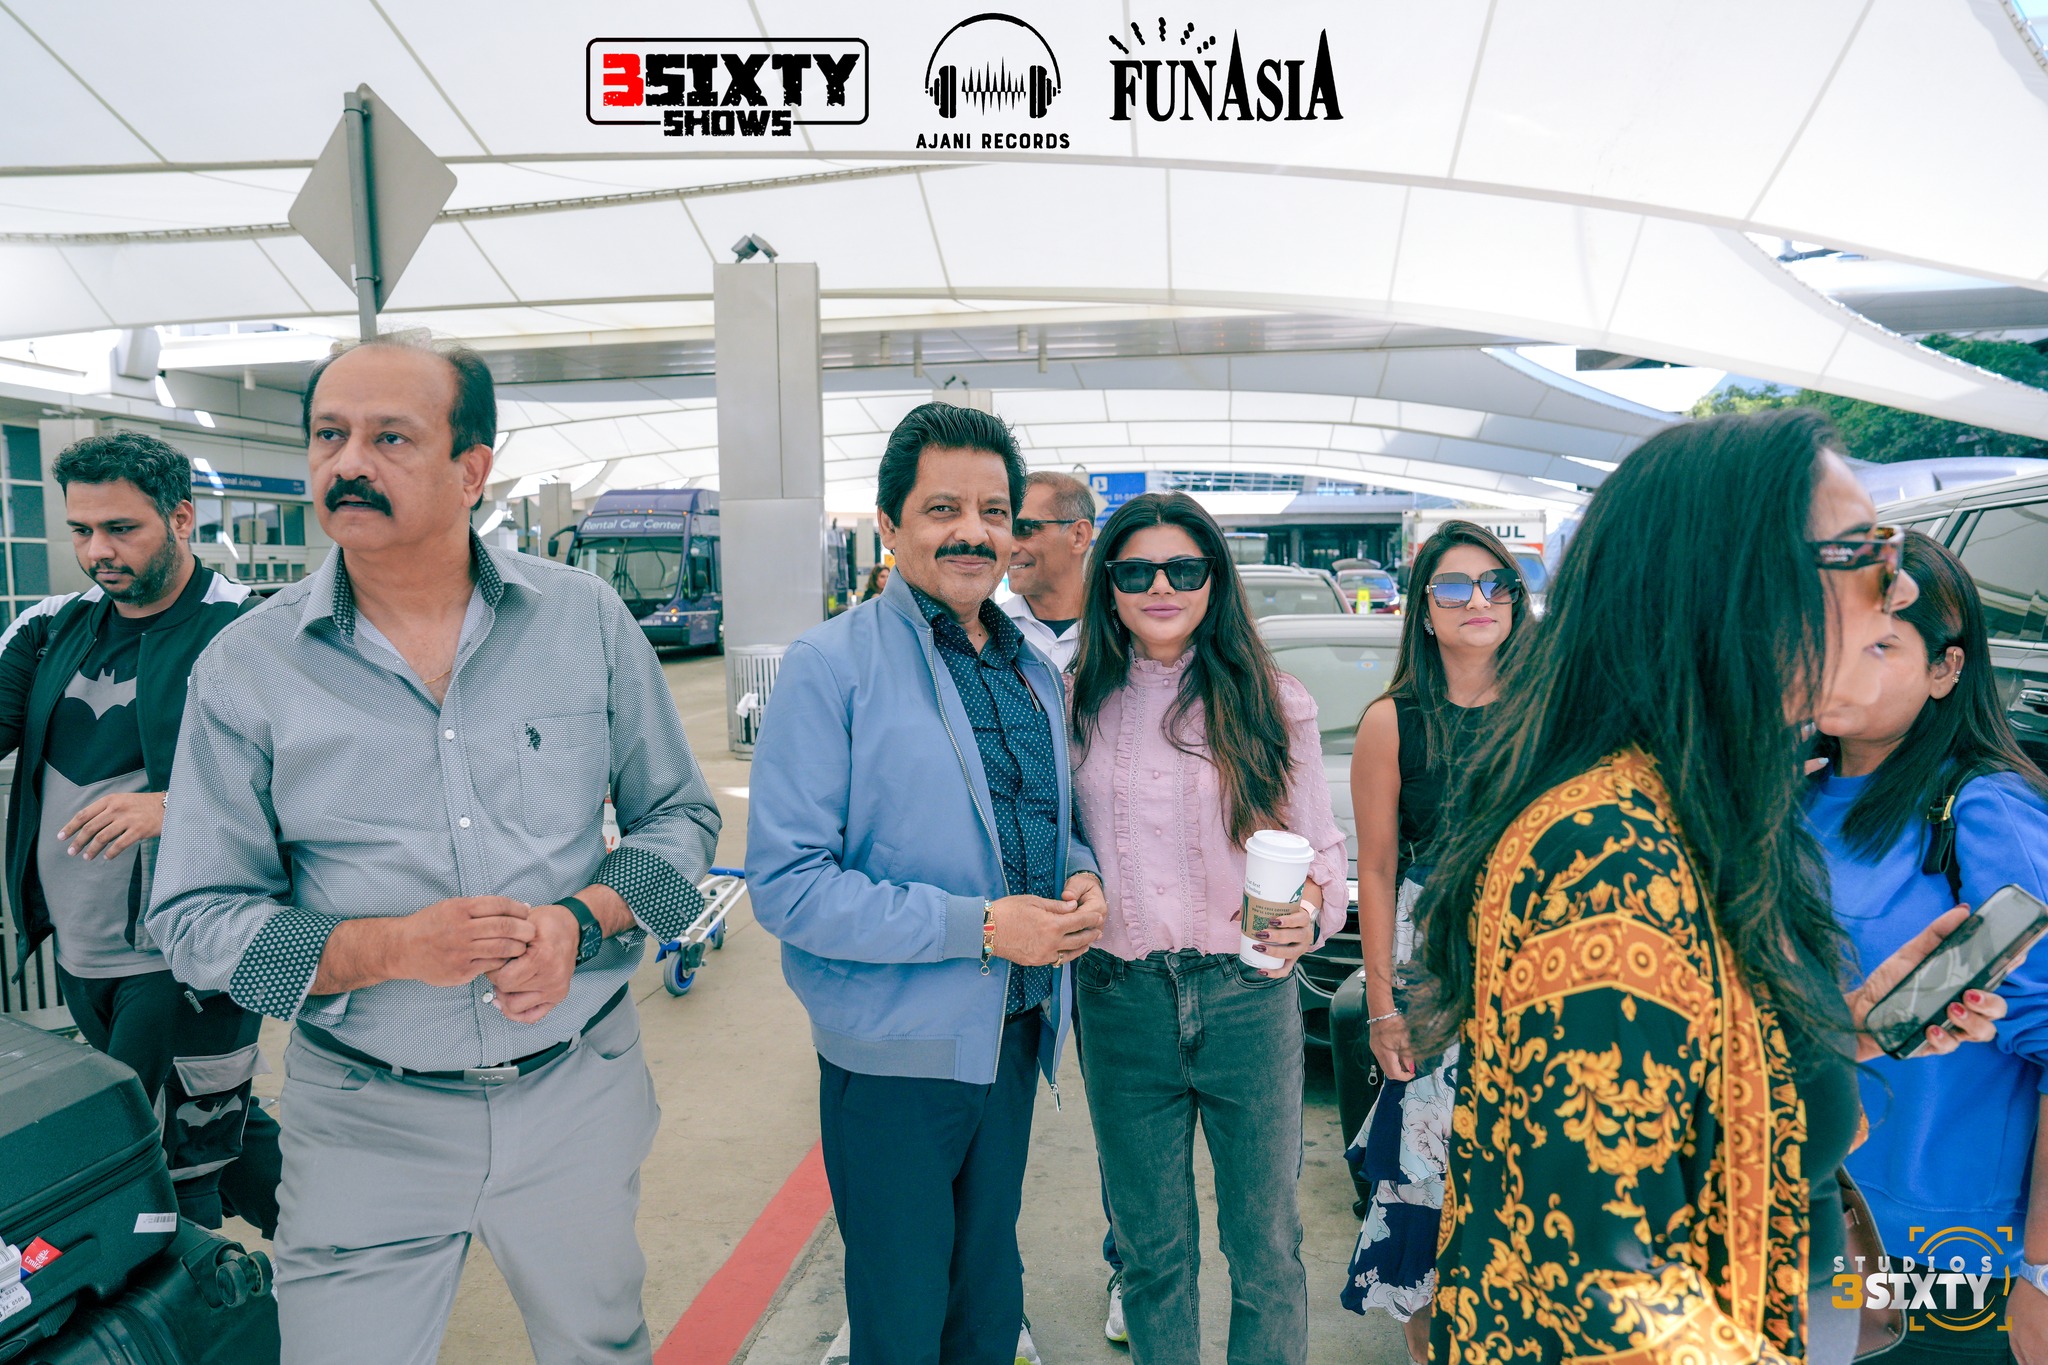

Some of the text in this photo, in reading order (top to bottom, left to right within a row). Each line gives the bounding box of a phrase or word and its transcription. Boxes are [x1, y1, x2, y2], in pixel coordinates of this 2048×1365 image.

[583, 518, 683, 531] Rental Car Center
